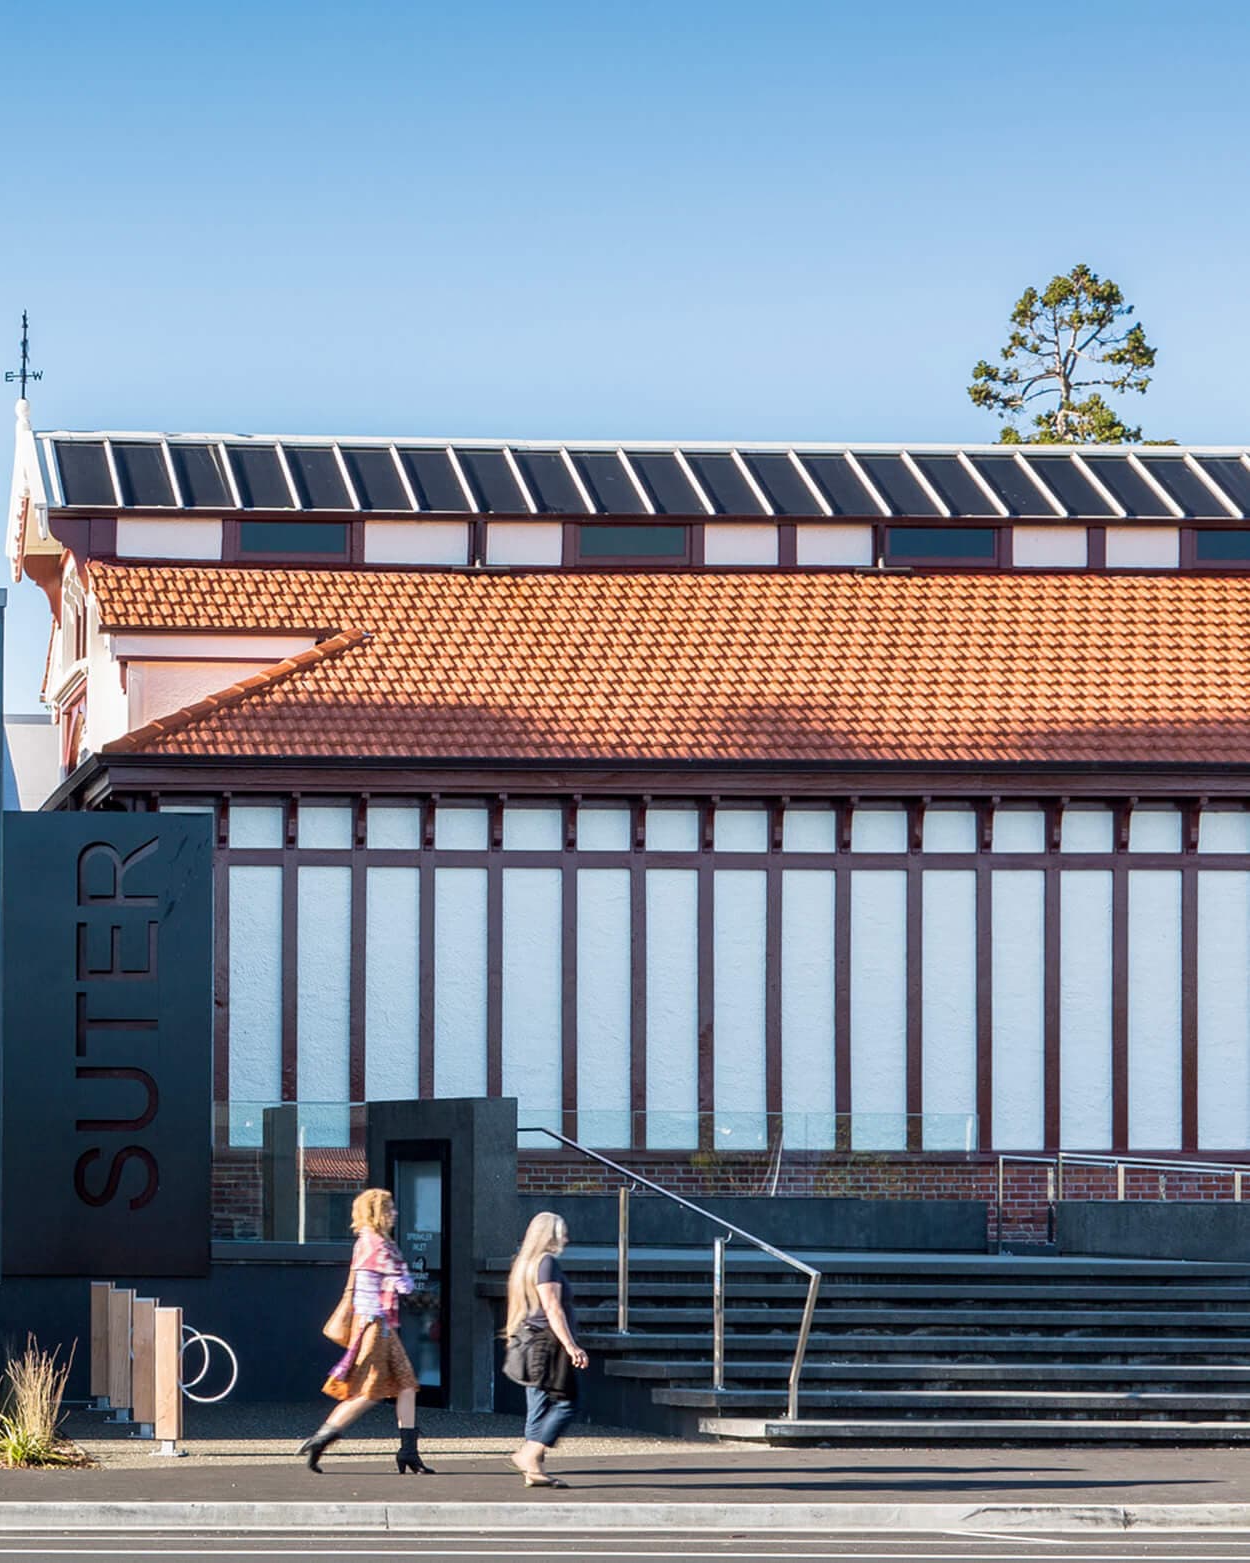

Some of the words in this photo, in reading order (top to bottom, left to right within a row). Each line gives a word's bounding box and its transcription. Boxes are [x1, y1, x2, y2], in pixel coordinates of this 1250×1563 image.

[5, 371, 14, 382] E
[32, 370, 43, 381] W
[74, 836, 159, 1210] SUTER
